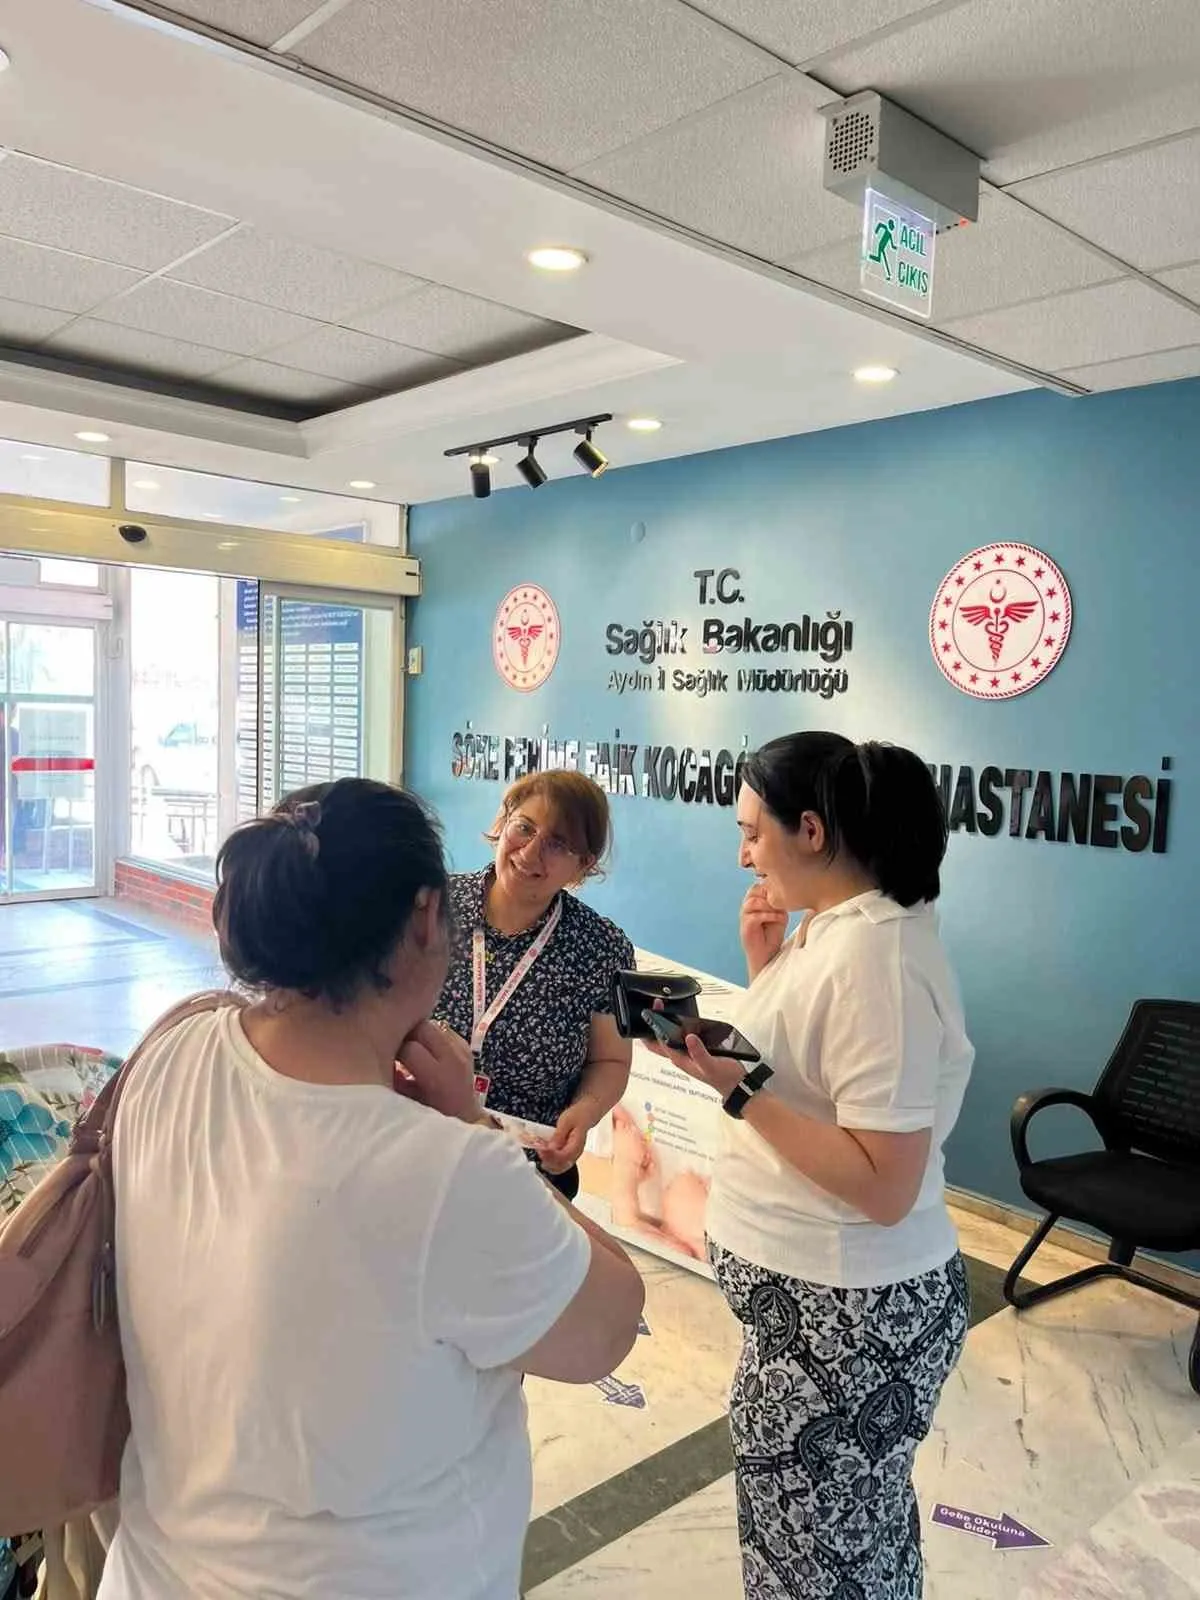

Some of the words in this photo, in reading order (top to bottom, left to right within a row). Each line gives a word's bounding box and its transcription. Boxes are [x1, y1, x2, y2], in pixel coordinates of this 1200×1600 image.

[693, 568, 745, 605] T.C.
[605, 620, 688, 665] Sağlık
[702, 610, 854, 663] Bakanlığı
[607, 671, 651, 695] Aydın
[672, 668, 729, 698] Sağlık
[737, 667, 850, 699] Müdürlüğü
[940, 1507, 971, 1522] Gebe
[974, 1517, 1026, 1538] Okuluna
[963, 1522, 998, 1537] Gider
